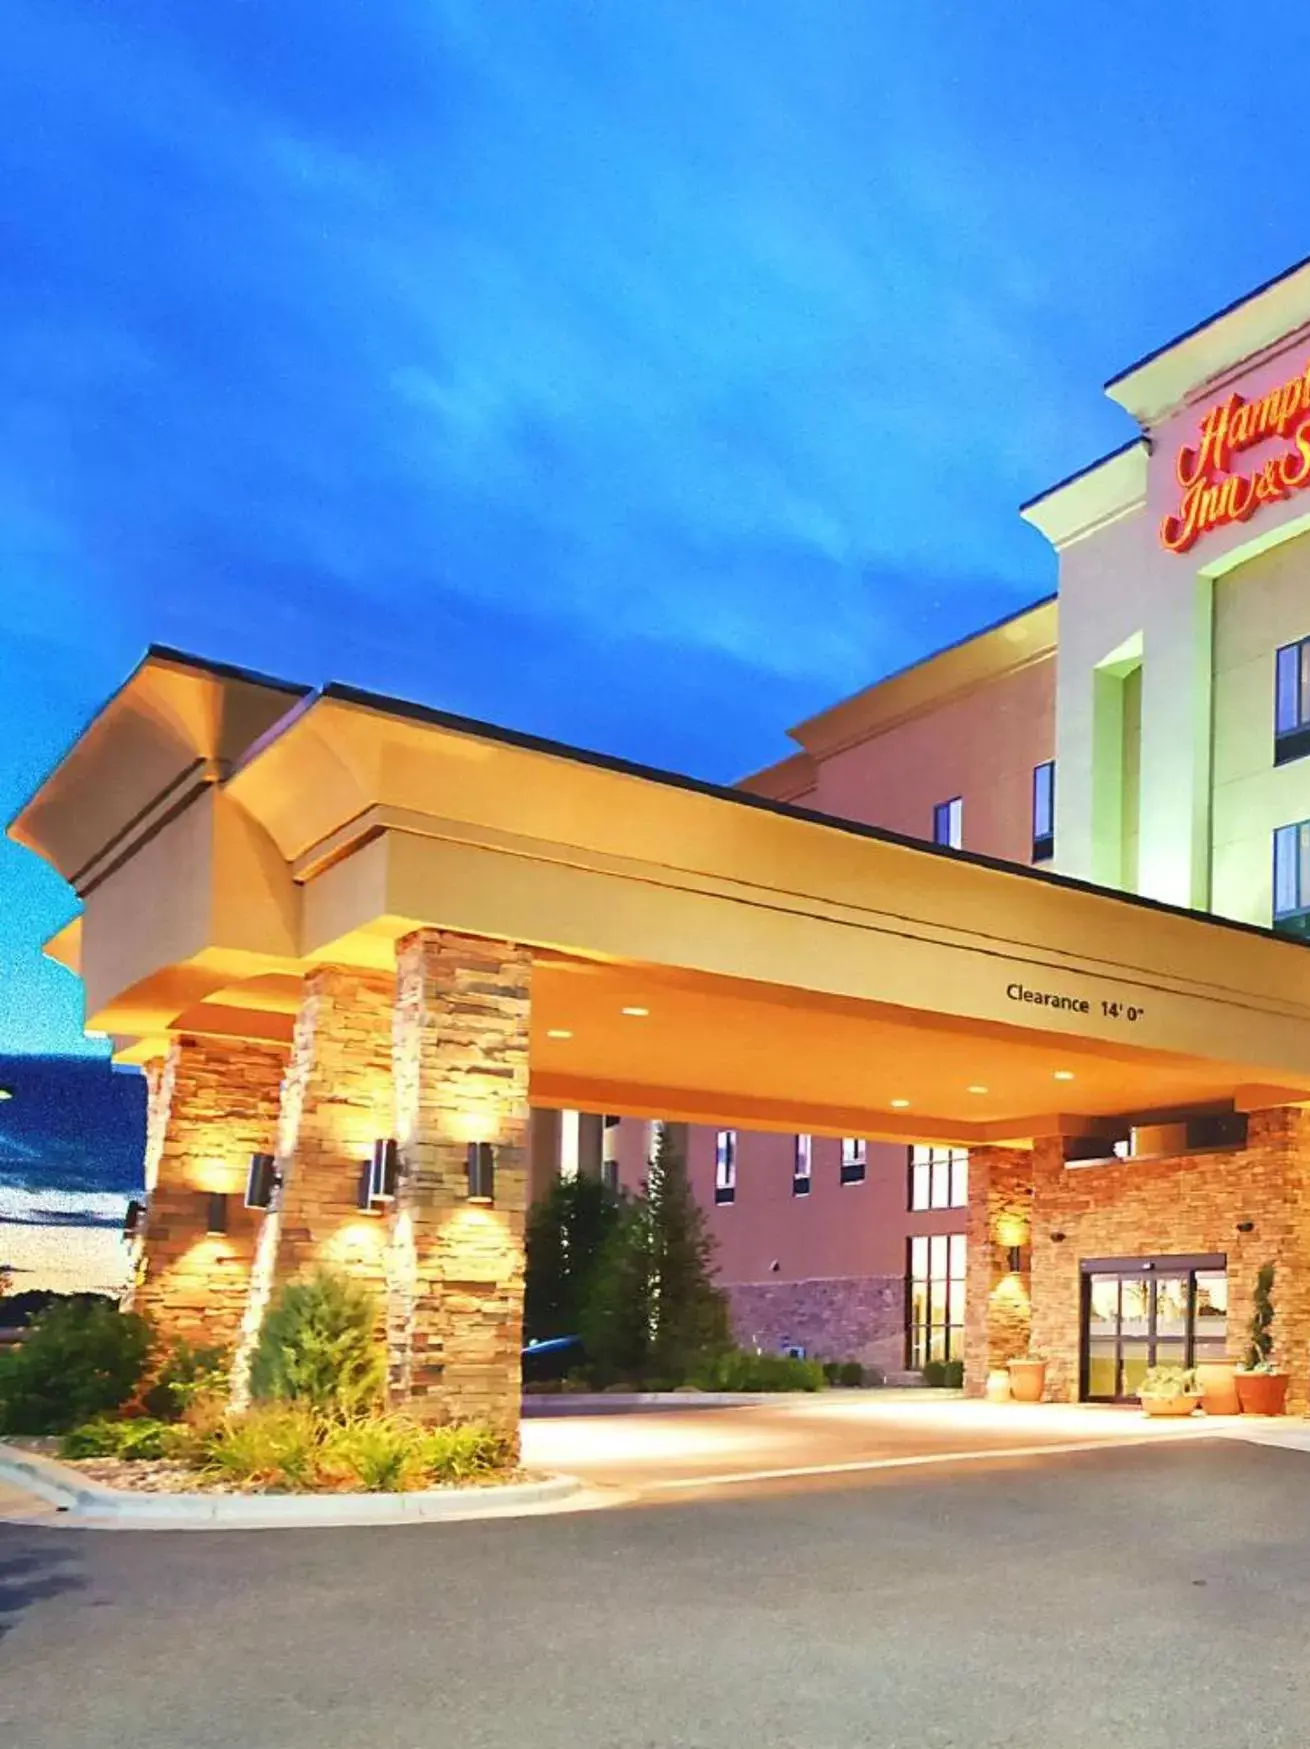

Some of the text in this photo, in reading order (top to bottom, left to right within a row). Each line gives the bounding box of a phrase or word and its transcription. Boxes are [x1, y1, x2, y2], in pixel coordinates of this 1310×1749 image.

[1160, 476, 1257, 552] Inn
[1255, 457, 1288, 501] &
[1006, 983, 1089, 1013] Clearance
